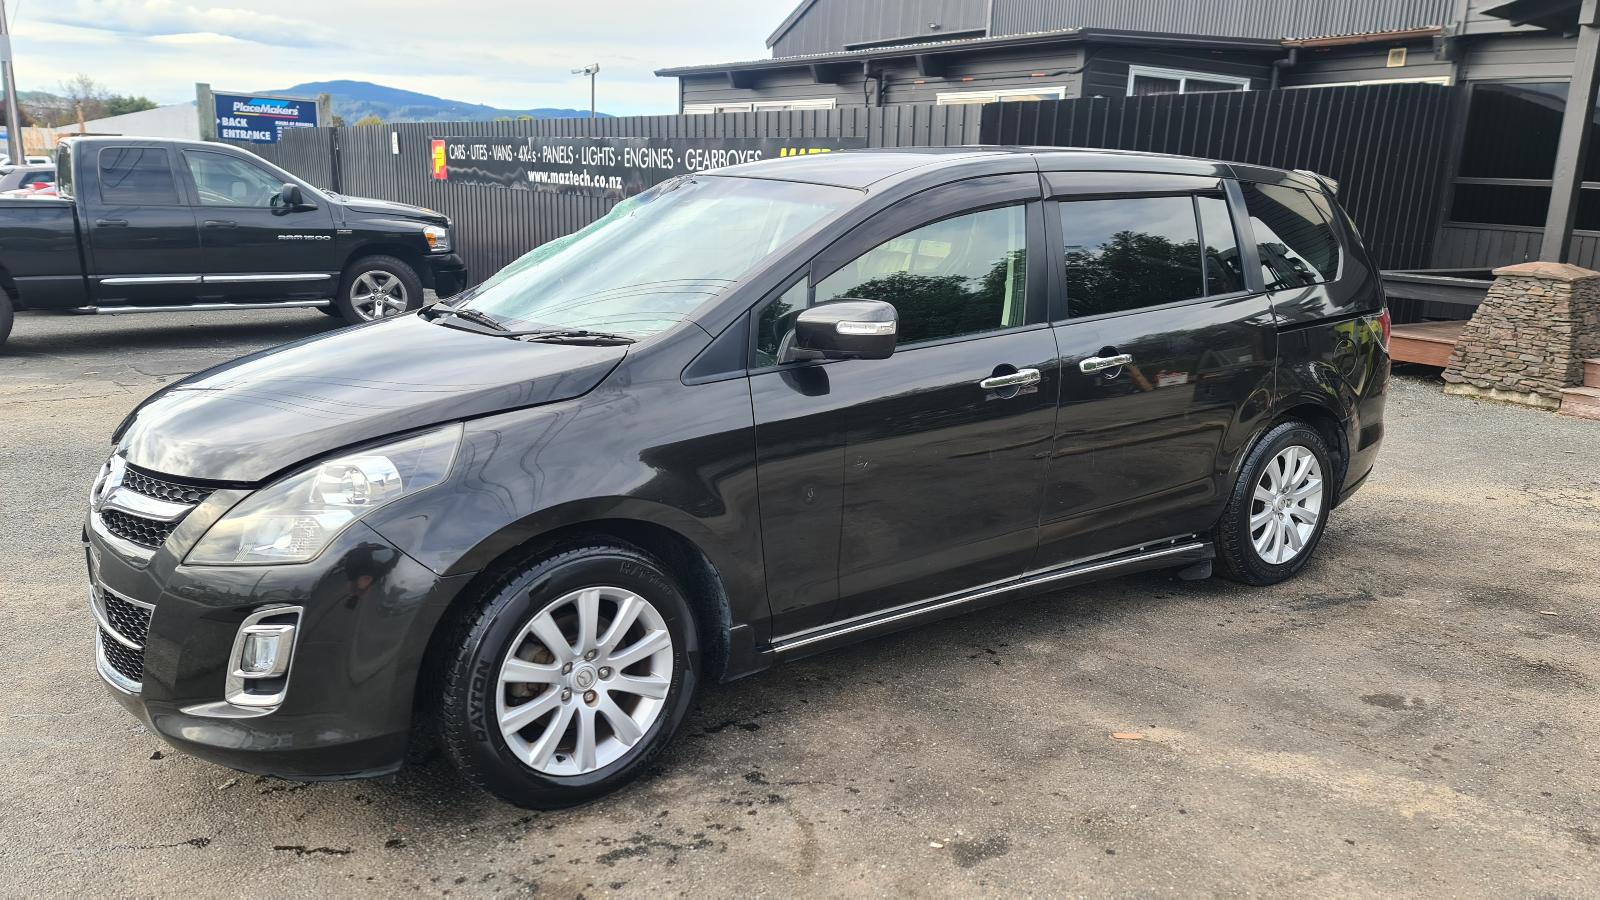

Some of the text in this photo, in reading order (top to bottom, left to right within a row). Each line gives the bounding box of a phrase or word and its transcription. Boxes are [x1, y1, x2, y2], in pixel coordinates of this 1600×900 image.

[233, 101, 298, 115] PlaceMakers
[221, 117, 248, 127] BACK
[223, 129, 271, 140] ENTRANCE
[449, 144, 466, 160] CARS
[470, 144, 488, 160] UTES
[492, 145, 513, 162] VANS
[542, 145, 573, 164] PANELS
[581, 146, 616, 166] LIGHTS
[624, 147, 674, 169] ENGINES
[528, 169, 622, 189] www.maztech.co.nz
